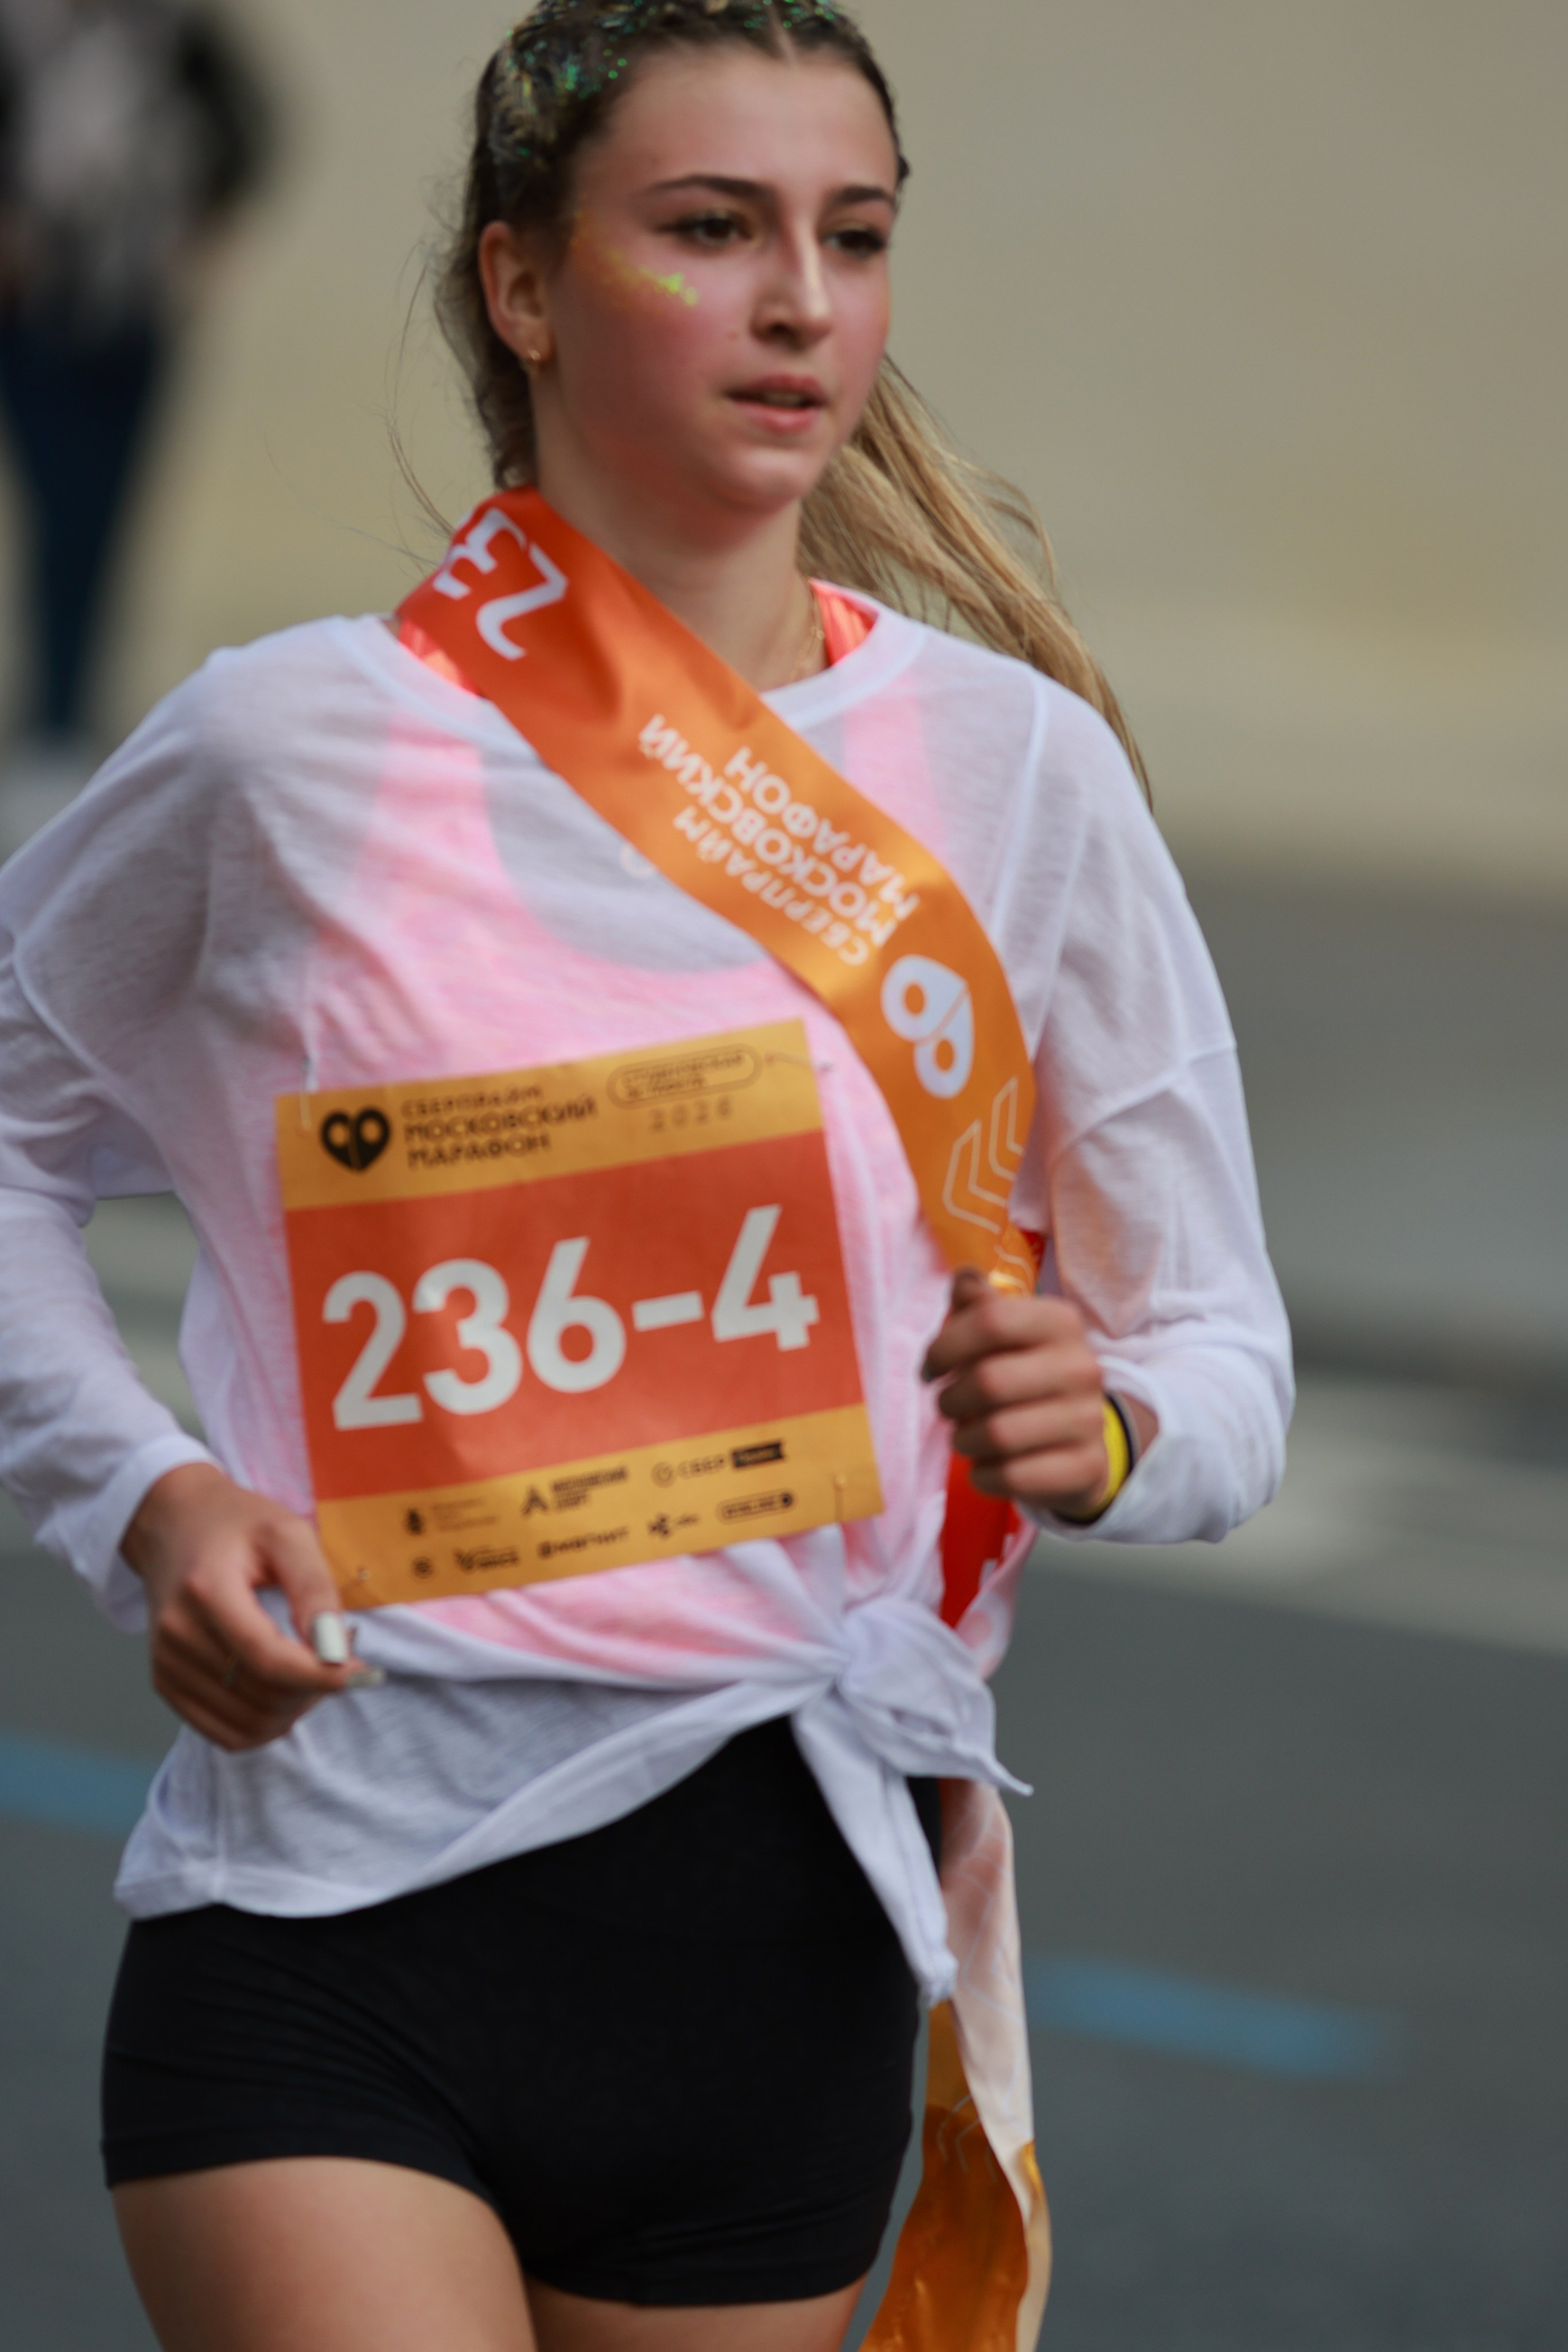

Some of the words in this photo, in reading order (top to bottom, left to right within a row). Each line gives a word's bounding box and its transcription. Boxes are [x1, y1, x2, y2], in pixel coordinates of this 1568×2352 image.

[638, 714, 899, 948] МОСКОВСКИЙ
[673, 806, 870, 966] СБЕРПРАЙМ
[723, 747, 919, 919] МАРАФОН
[404, 1090, 599, 1144] МОСКОВСКИЙ
[407, 1132, 551, 1171] МАРАФОН
[322, 1203, 820, 1431] 236-4
